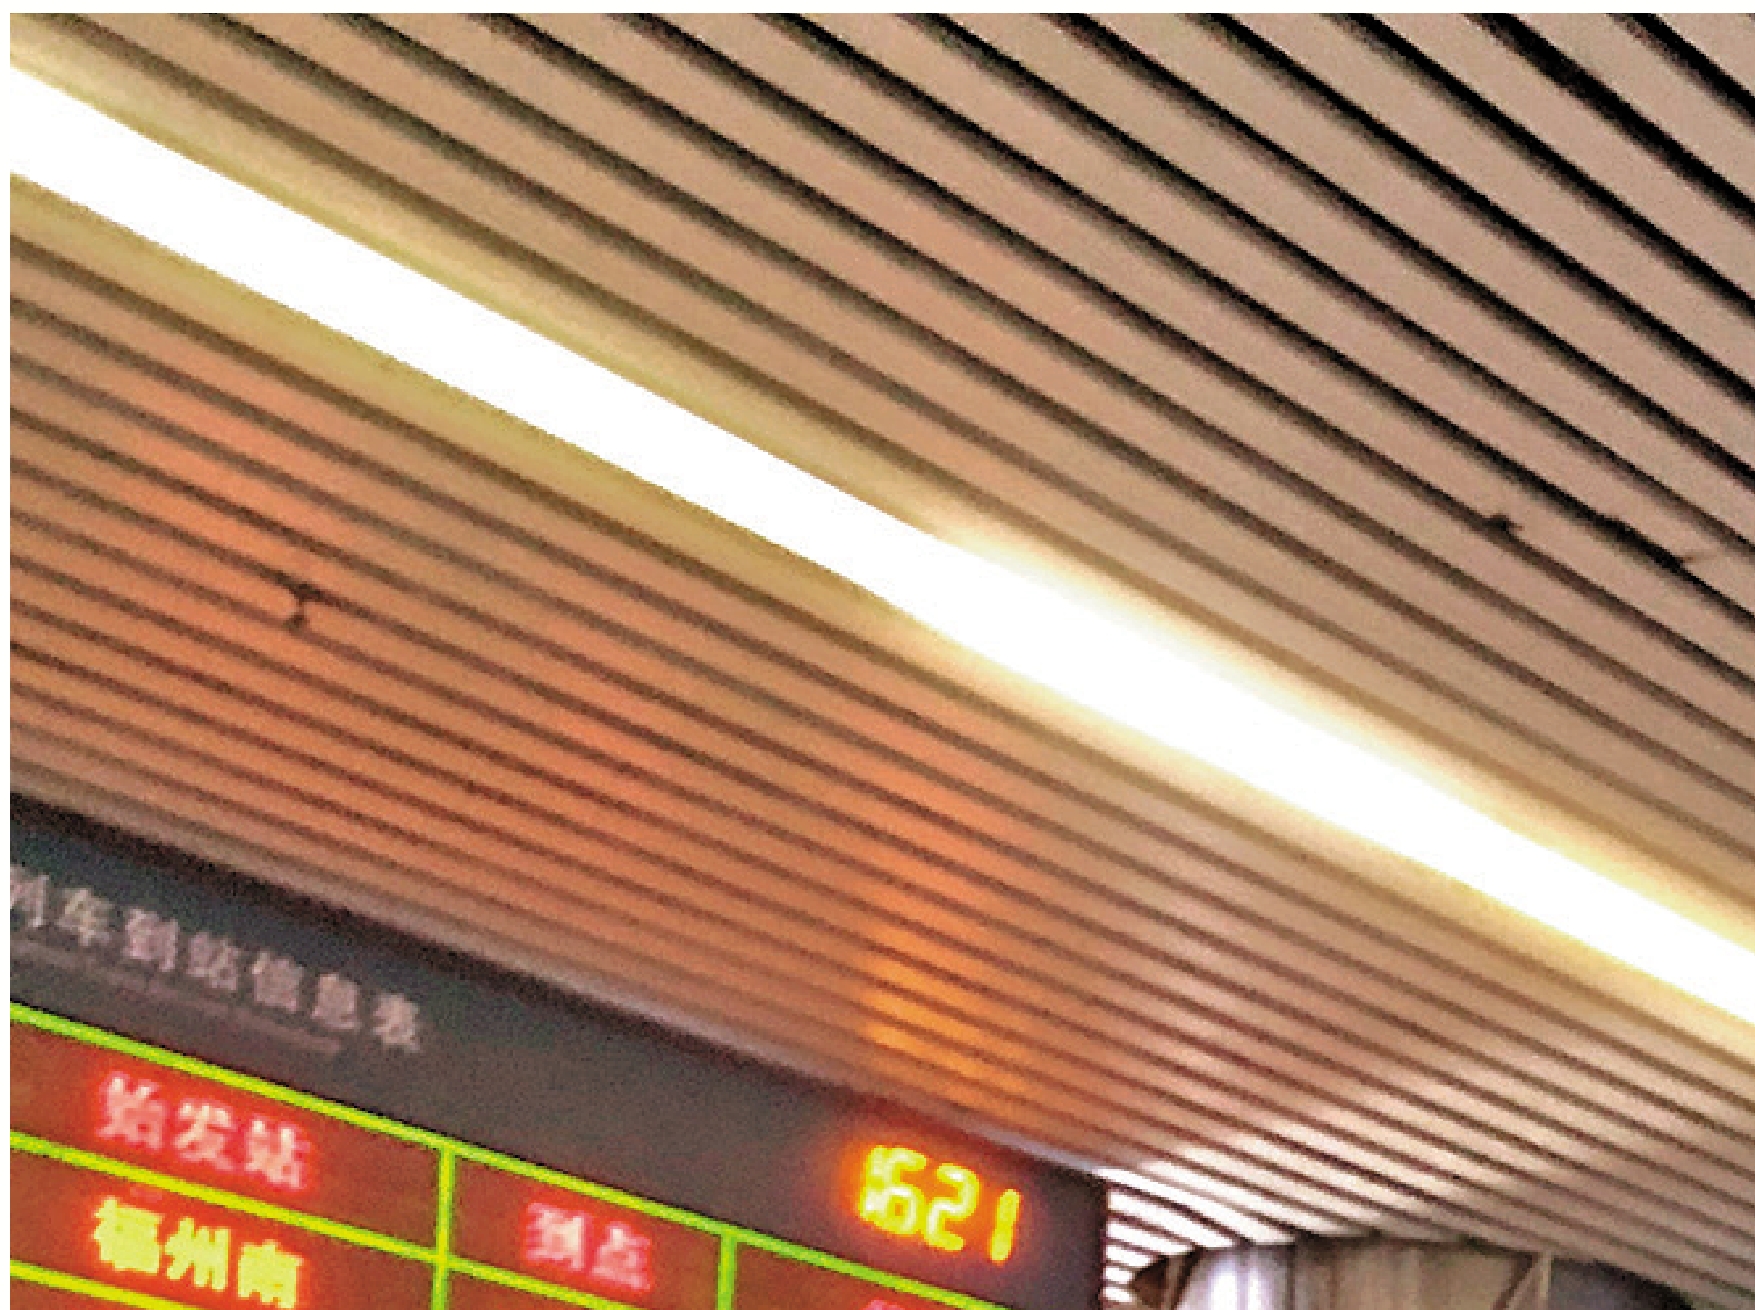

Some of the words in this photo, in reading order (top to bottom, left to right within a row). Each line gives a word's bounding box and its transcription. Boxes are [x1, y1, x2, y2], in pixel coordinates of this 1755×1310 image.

[92, 1195, 305, 1310] 福州南
[97, 1069, 317, 1192] 始发站
[522, 1200, 654, 1293] 到点
